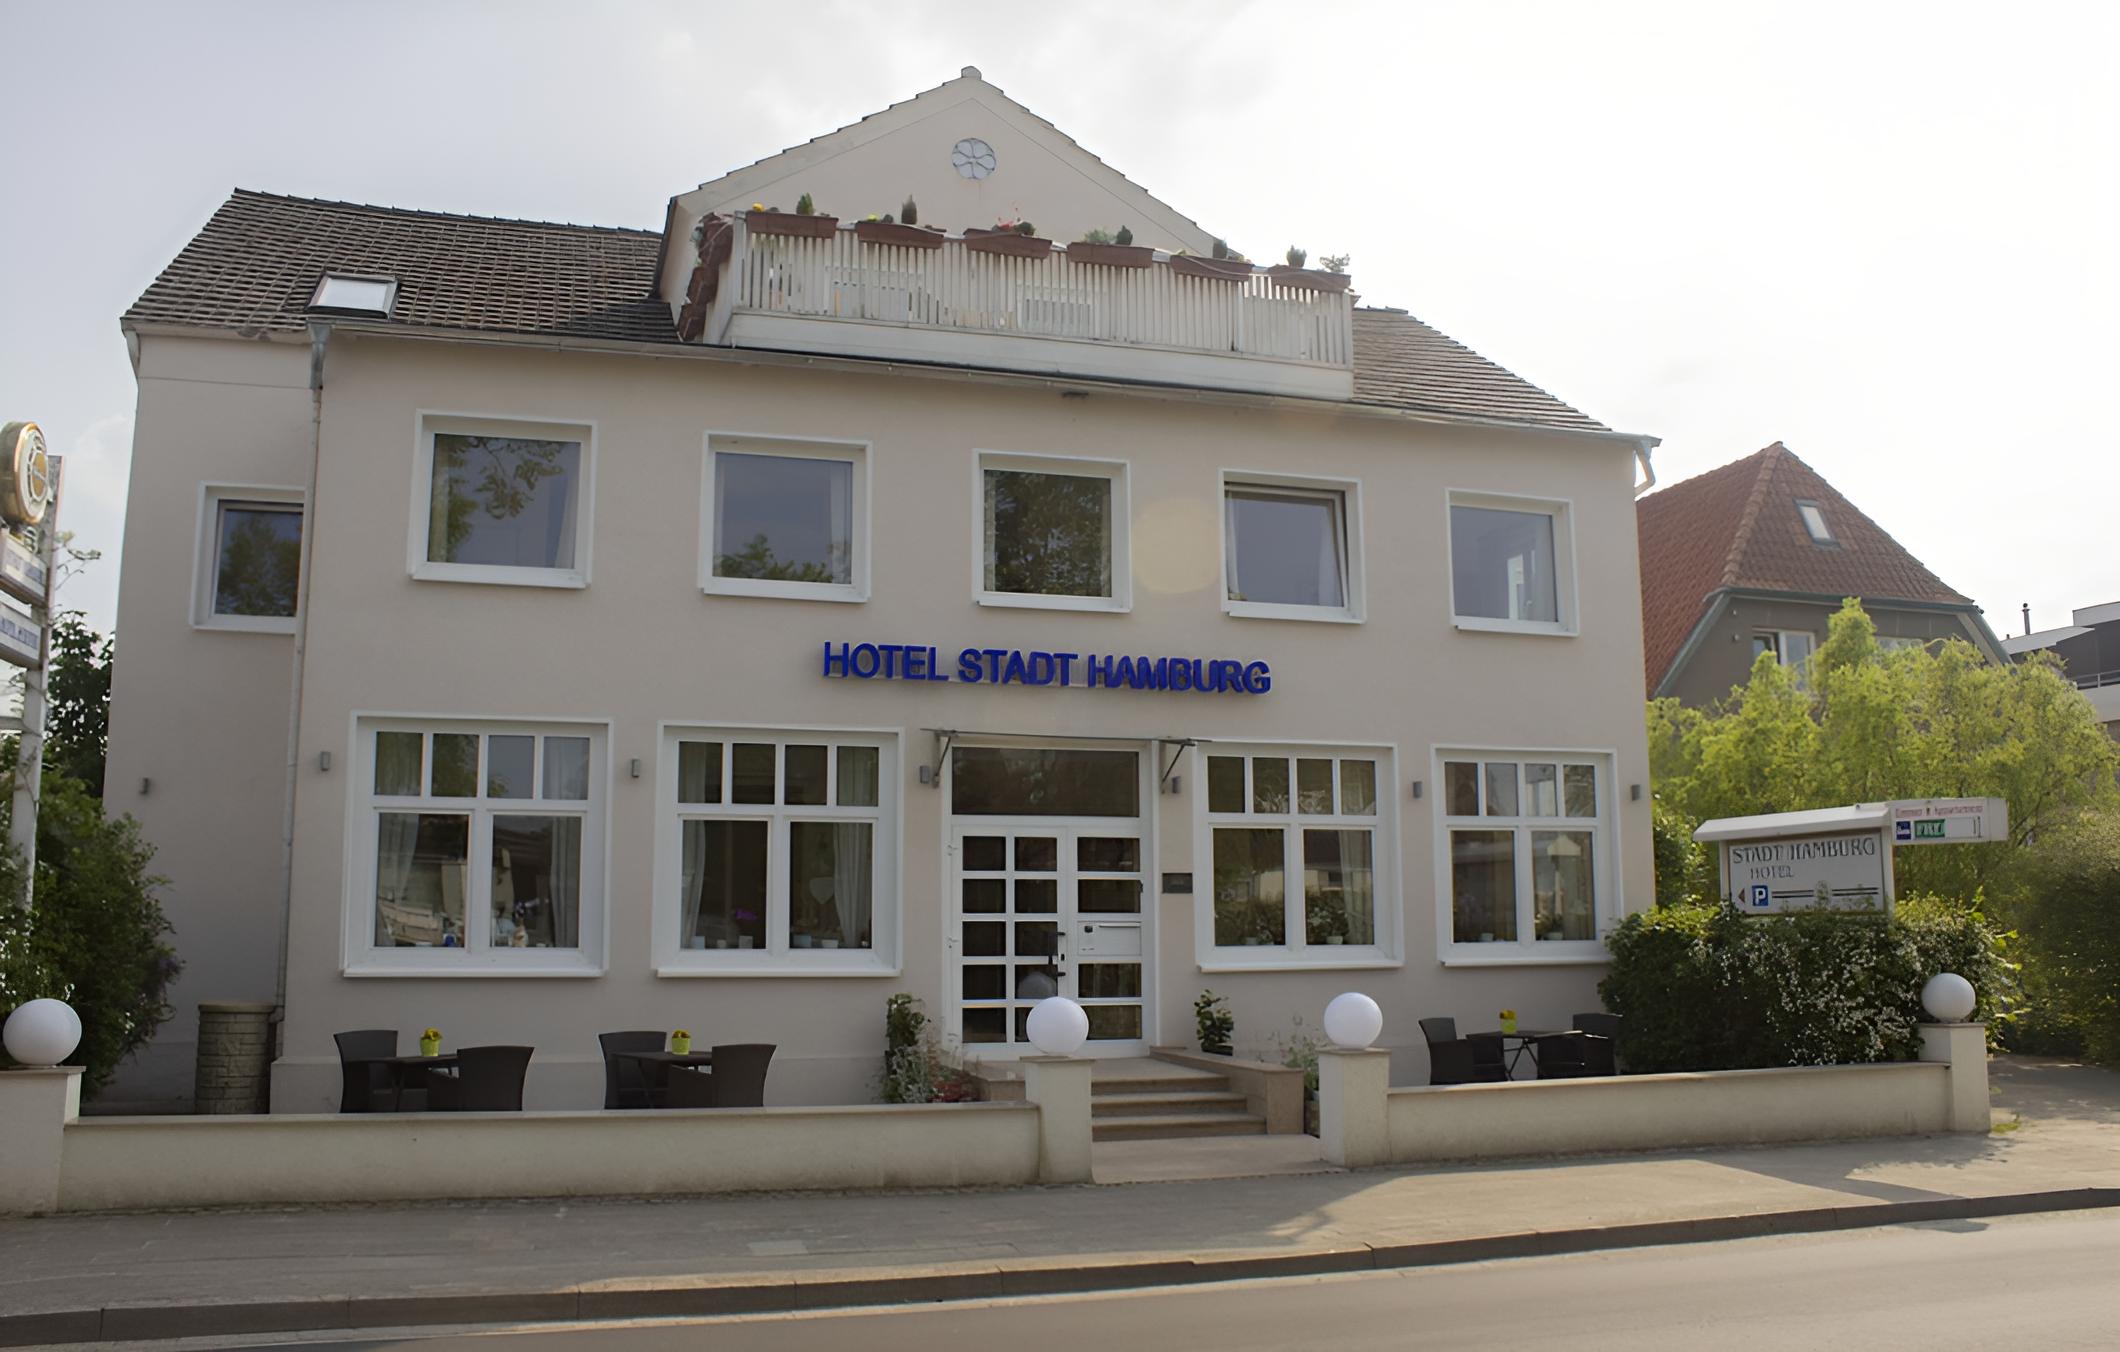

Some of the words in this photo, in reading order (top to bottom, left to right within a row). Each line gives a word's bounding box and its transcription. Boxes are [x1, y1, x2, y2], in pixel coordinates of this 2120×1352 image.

[823, 640, 949, 681] HOTEL
[957, 648, 1078, 686] STADT
[1087, 653, 1272, 694] HAMBURG
[1732, 845, 1783, 864] STADT
[1790, 837, 1876, 861] HAMBURG
[1750, 865, 1794, 880] HOTEL
[1754, 887, 1767, 905] P
